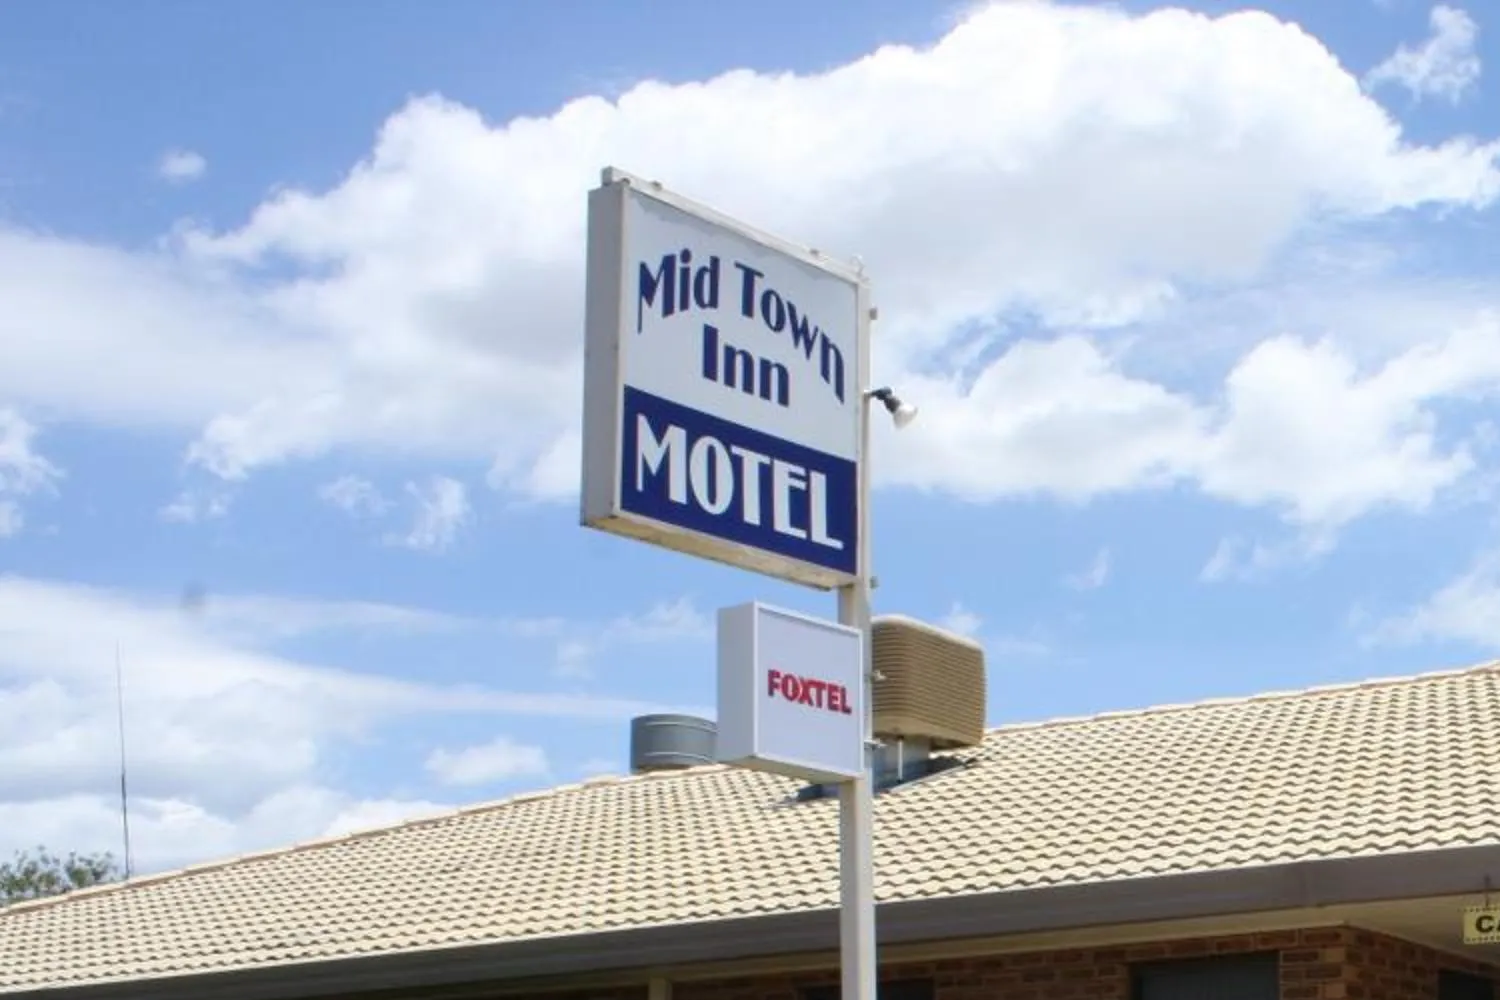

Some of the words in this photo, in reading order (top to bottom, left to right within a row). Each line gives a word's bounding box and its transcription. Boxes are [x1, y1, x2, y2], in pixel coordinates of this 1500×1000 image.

[637, 248, 720, 334] Mid
[734, 261, 845, 405] Town
[702, 323, 789, 407] Inn
[635, 412, 844, 551] MOTEL
[767, 668, 852, 715] FOXTEL
